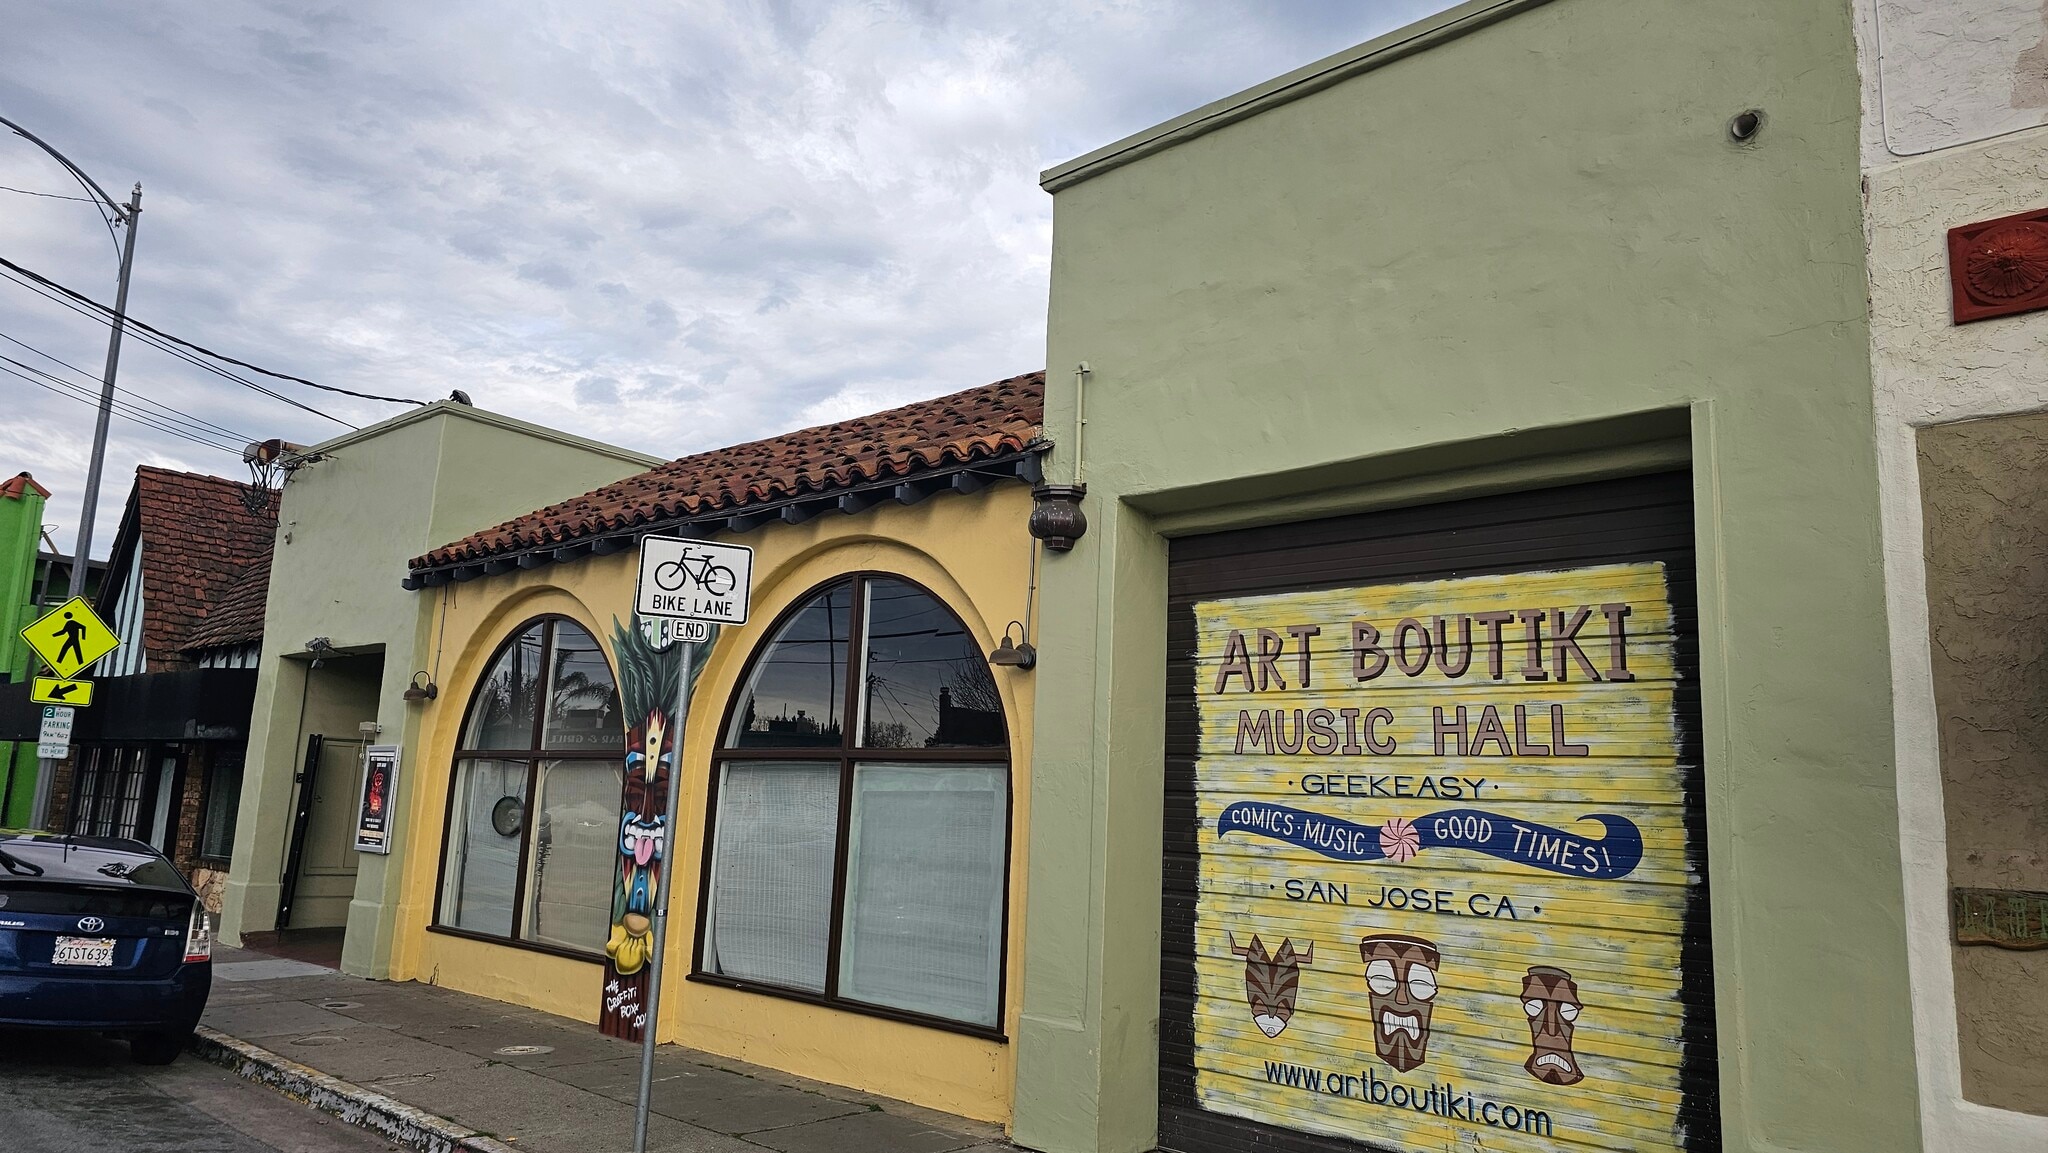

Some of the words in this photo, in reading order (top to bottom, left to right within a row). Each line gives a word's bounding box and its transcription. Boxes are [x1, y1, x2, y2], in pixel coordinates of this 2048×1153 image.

[652, 594, 686, 611] BIKE
[694, 599, 732, 616] LANE
[676, 622, 705, 638] END
[1214, 625, 1320, 695] ART
[1351, 602, 1636, 683] BOUTIKI
[45, 708, 53, 717] 2
[43, 720, 71, 730] PARKING
[1234, 706, 1397, 756] MUSIC
[1432, 704, 1589, 757] HALL
[1300, 774, 1486, 799] GEEKEASY
[1231, 807, 1294, 836] COMICS
[1303, 818, 1365, 855] MUSIC
[1434, 815, 1493, 843] GOOD
[1511, 823, 1613, 874] TIMES!
[1285, 879, 1348, 905] SAN
[58, 946, 109, 961] 6TST639
[605, 979, 619, 994] THE
[620, 1002, 640, 1019] BOXX
[1264, 1059, 1554, 1137] www.artboutiki.com
